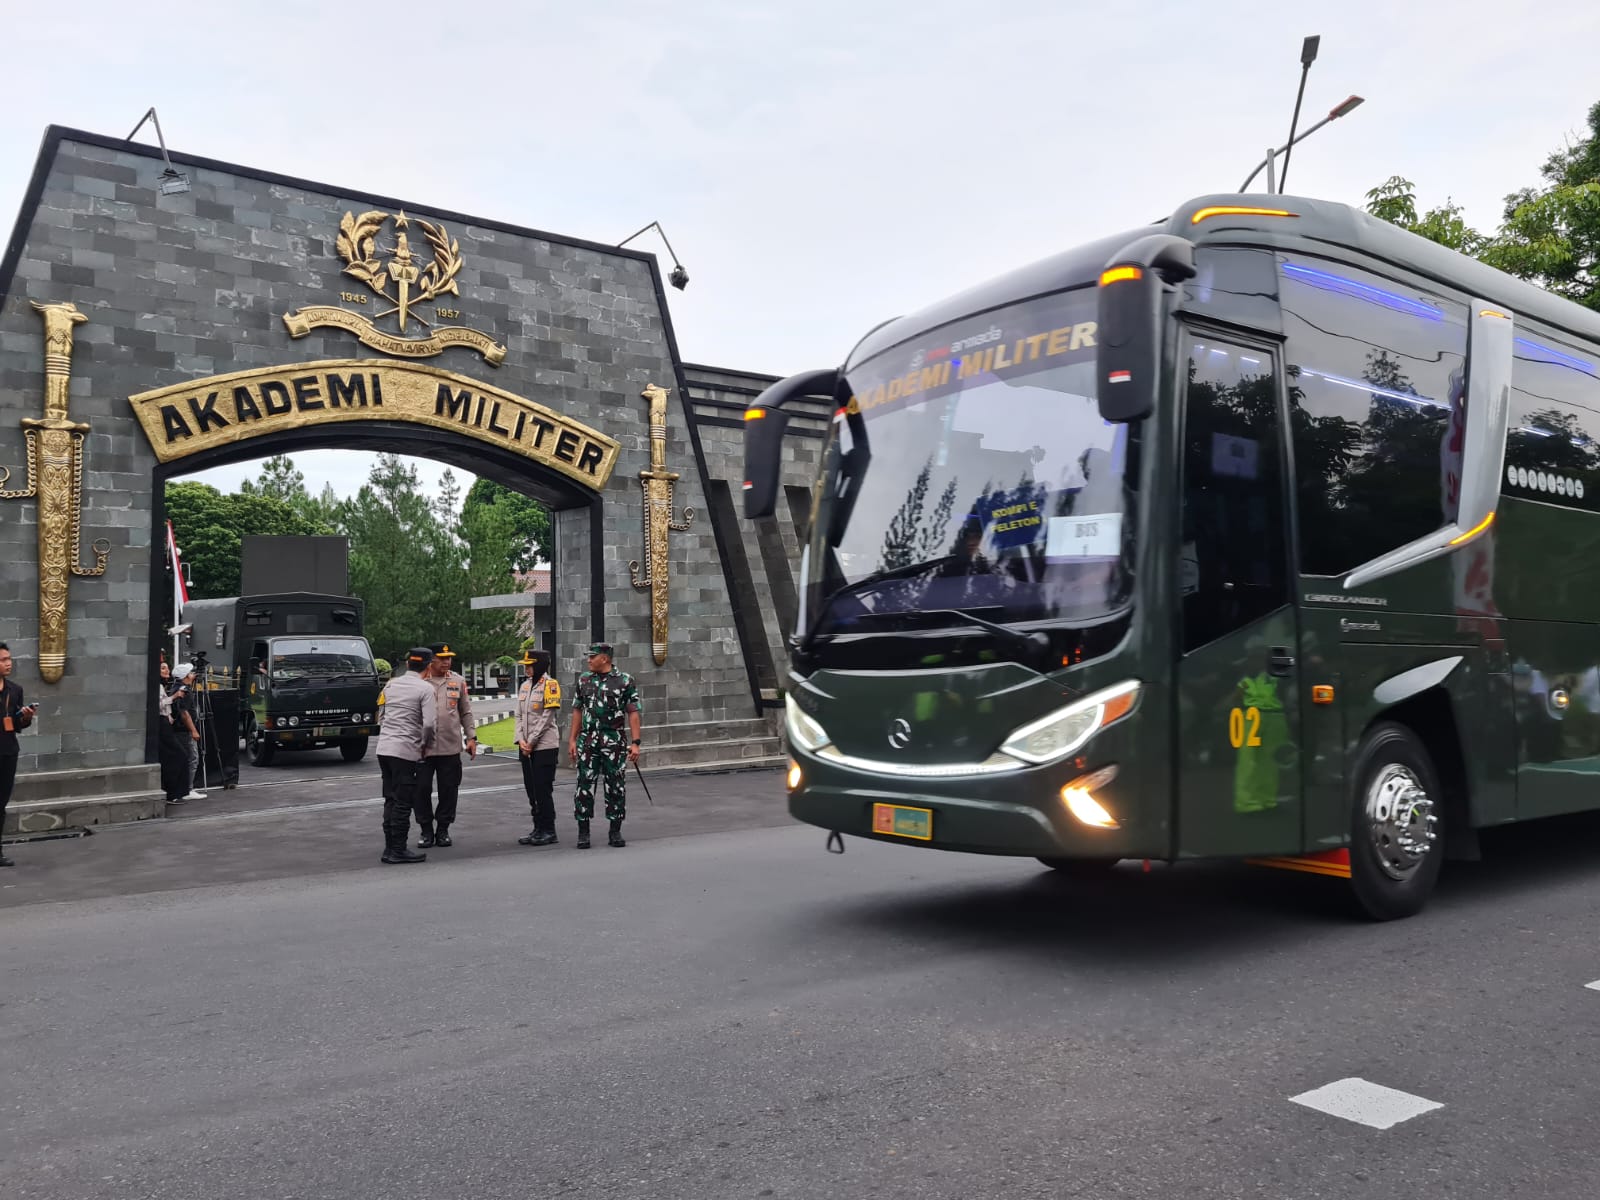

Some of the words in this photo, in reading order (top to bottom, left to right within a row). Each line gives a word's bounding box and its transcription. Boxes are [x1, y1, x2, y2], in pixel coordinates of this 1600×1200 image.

[340, 291, 368, 304] 1945
[436, 307, 460, 318] 1957
[845, 361, 951, 415] AKADEMI
[957, 321, 1098, 380] MILITER
[160, 373, 384, 443] AKADEMI
[434, 383, 604, 476] MILITER
[305, 708, 349, 716] MITSUBISHI
[1229, 706, 1262, 748] 02
